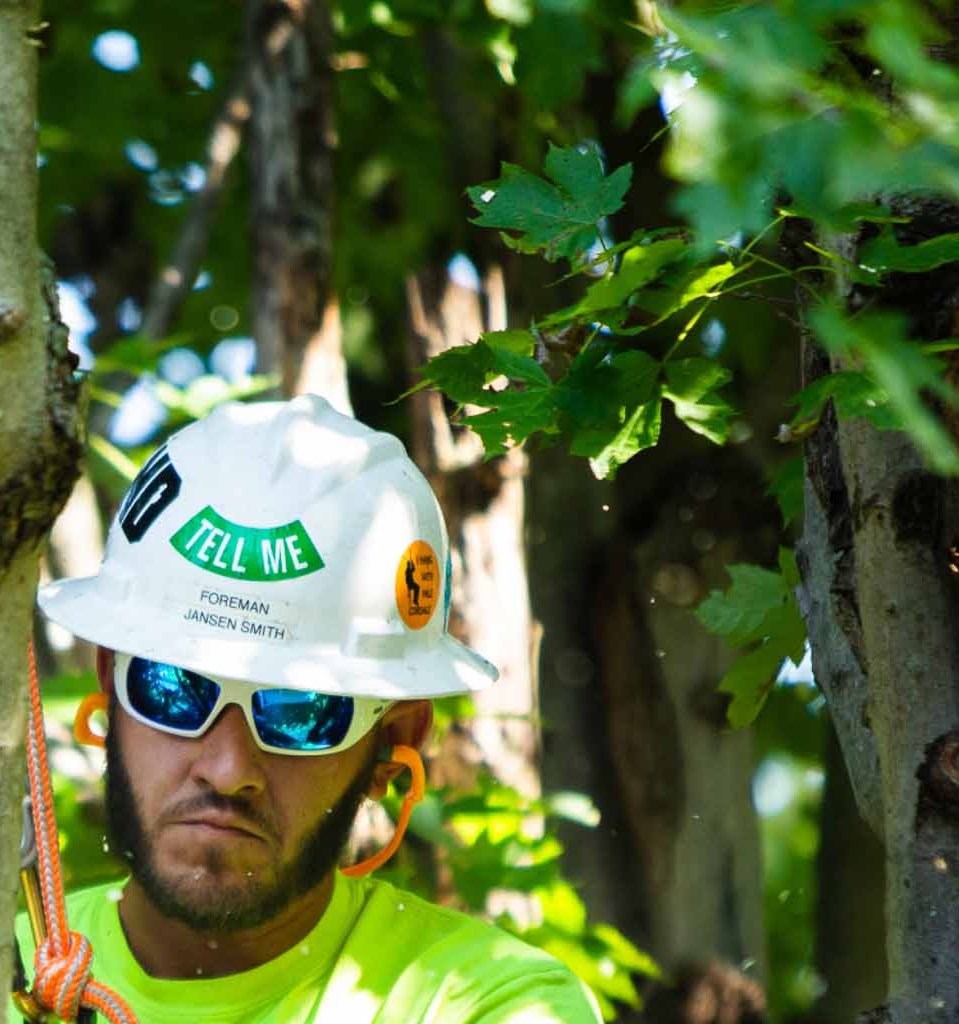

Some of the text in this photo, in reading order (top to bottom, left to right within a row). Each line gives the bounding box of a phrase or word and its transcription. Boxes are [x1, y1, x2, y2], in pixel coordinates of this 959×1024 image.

[185, 518, 308, 575] TELL ME
[200, 590, 270, 615] FOREMAN
[184, 609, 285, 640] JANSEN SMITH
